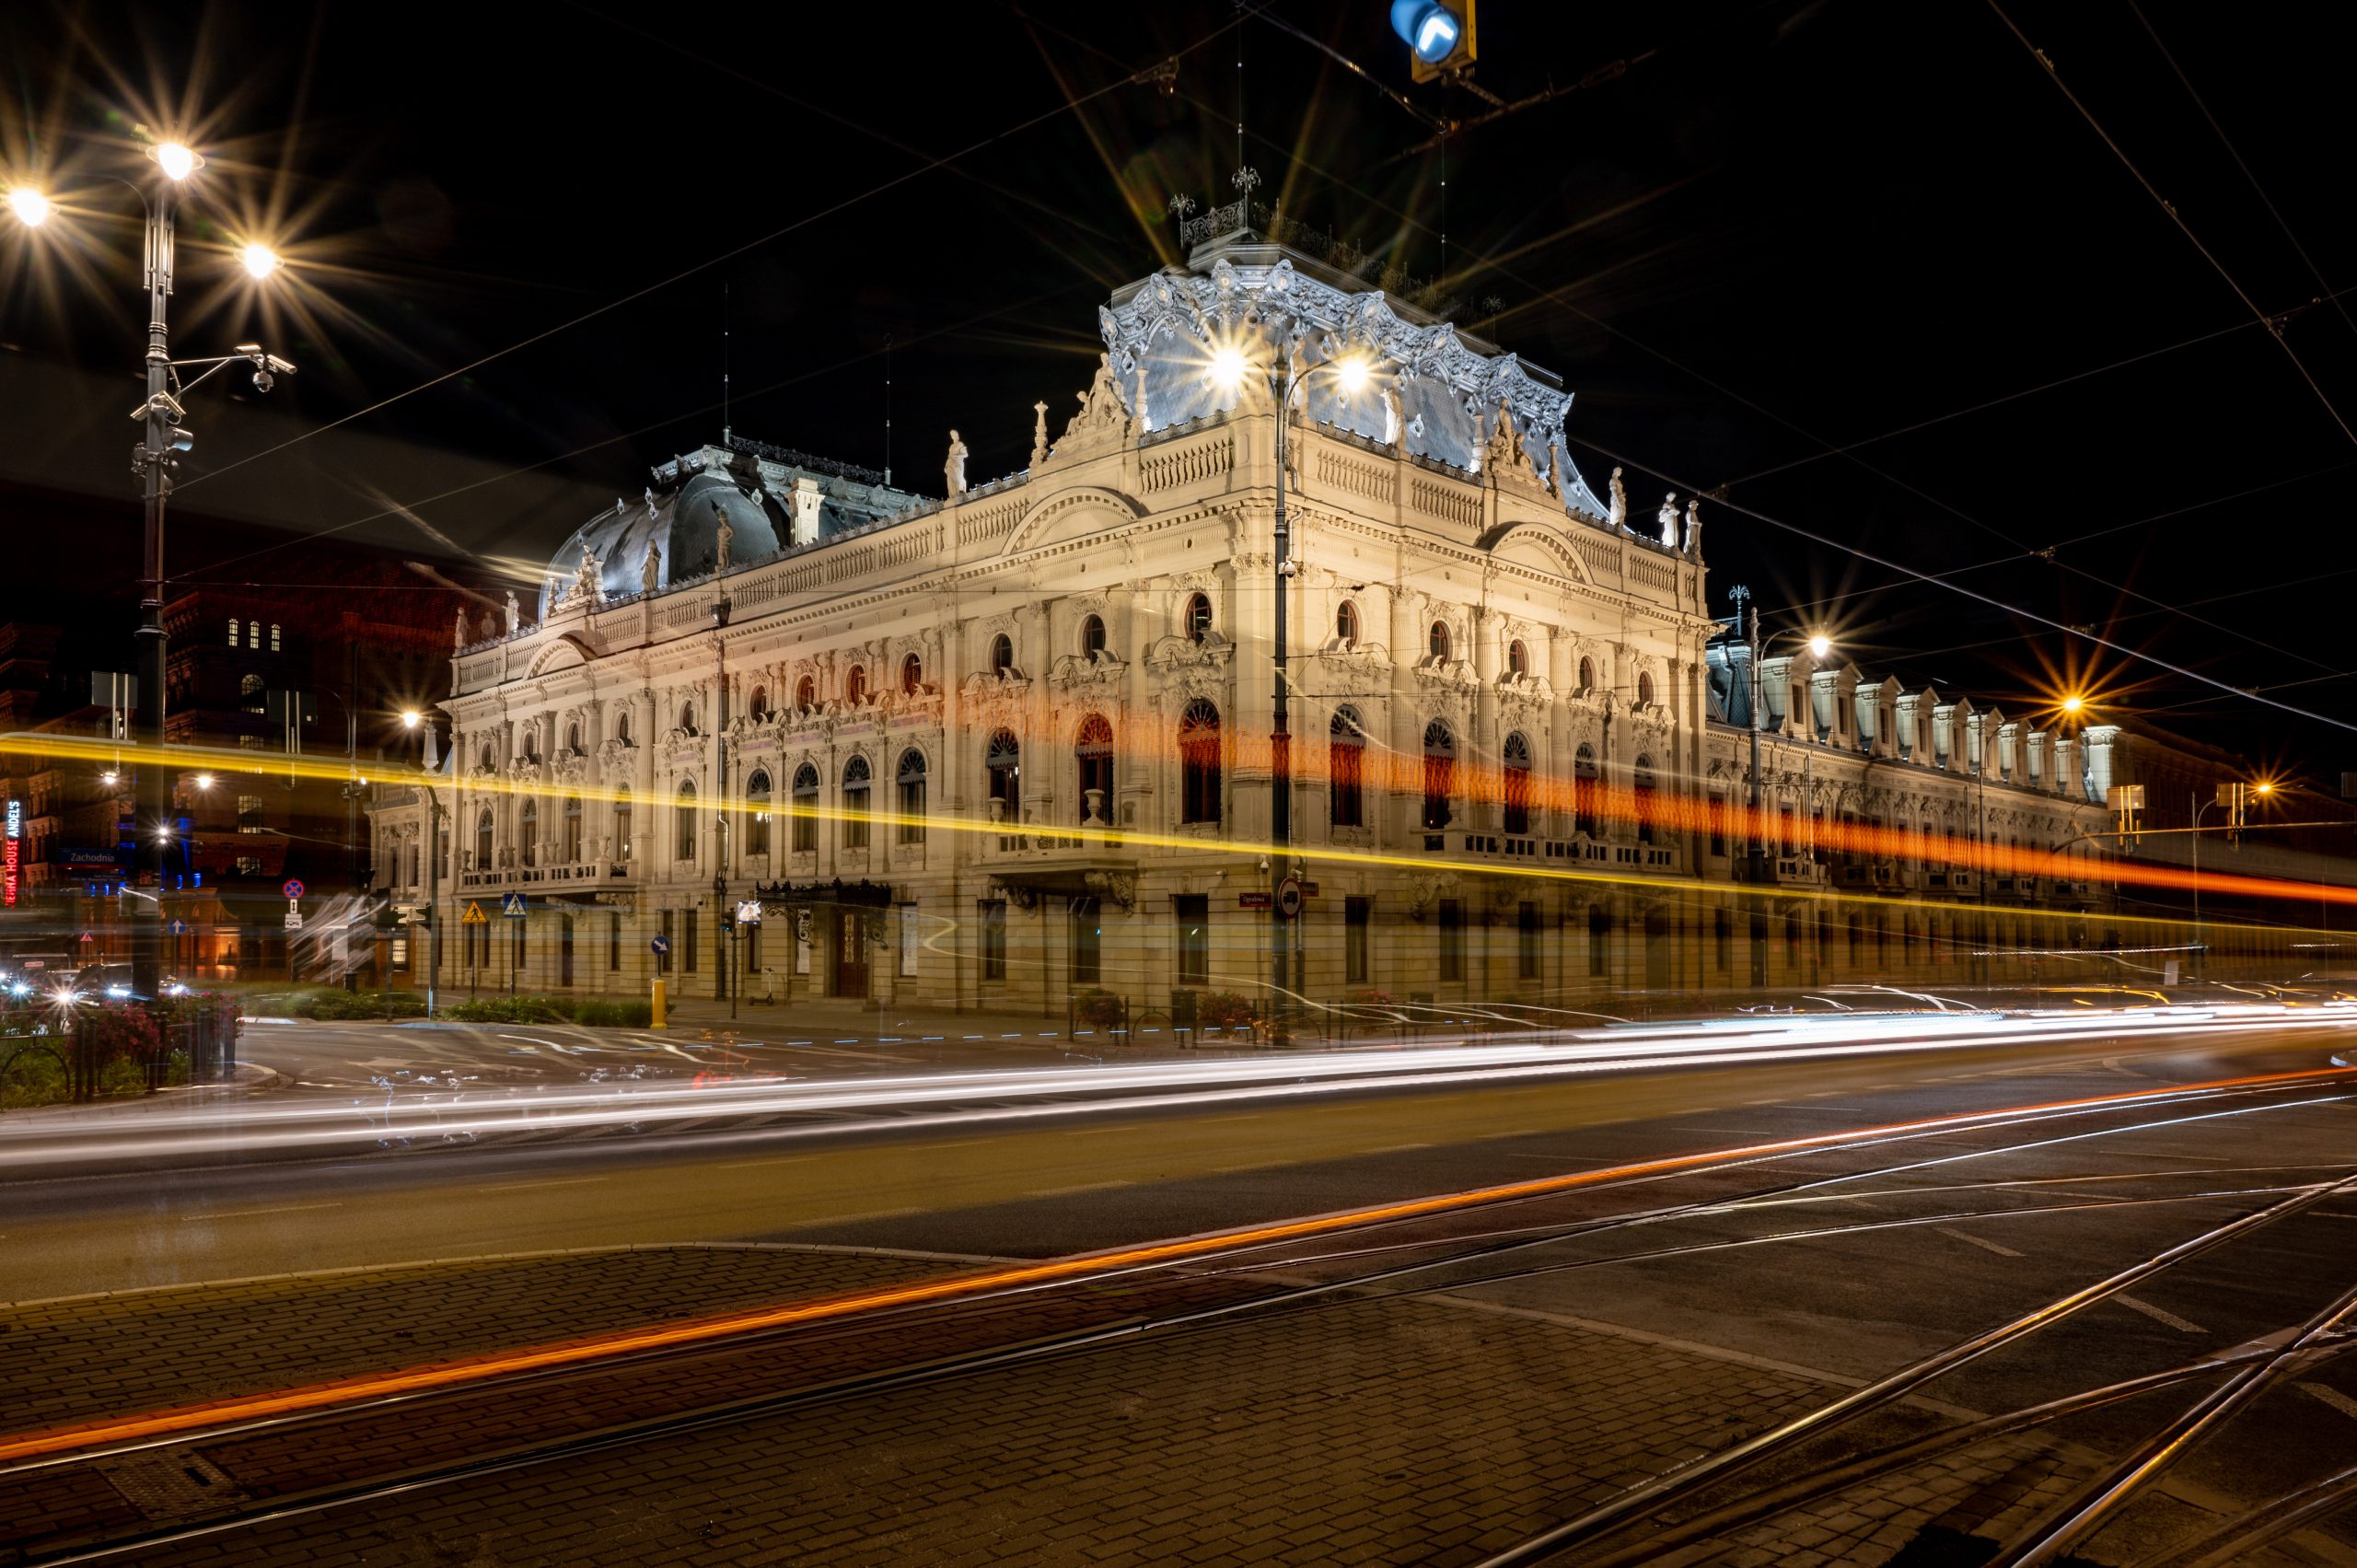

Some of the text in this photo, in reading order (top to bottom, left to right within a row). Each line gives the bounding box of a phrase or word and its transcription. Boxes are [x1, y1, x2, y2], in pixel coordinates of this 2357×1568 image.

[7, 800, 19, 837] ANDEL'S
[6, 840, 17, 872] HOUSE
[70, 853, 115, 863] Zachodnia
